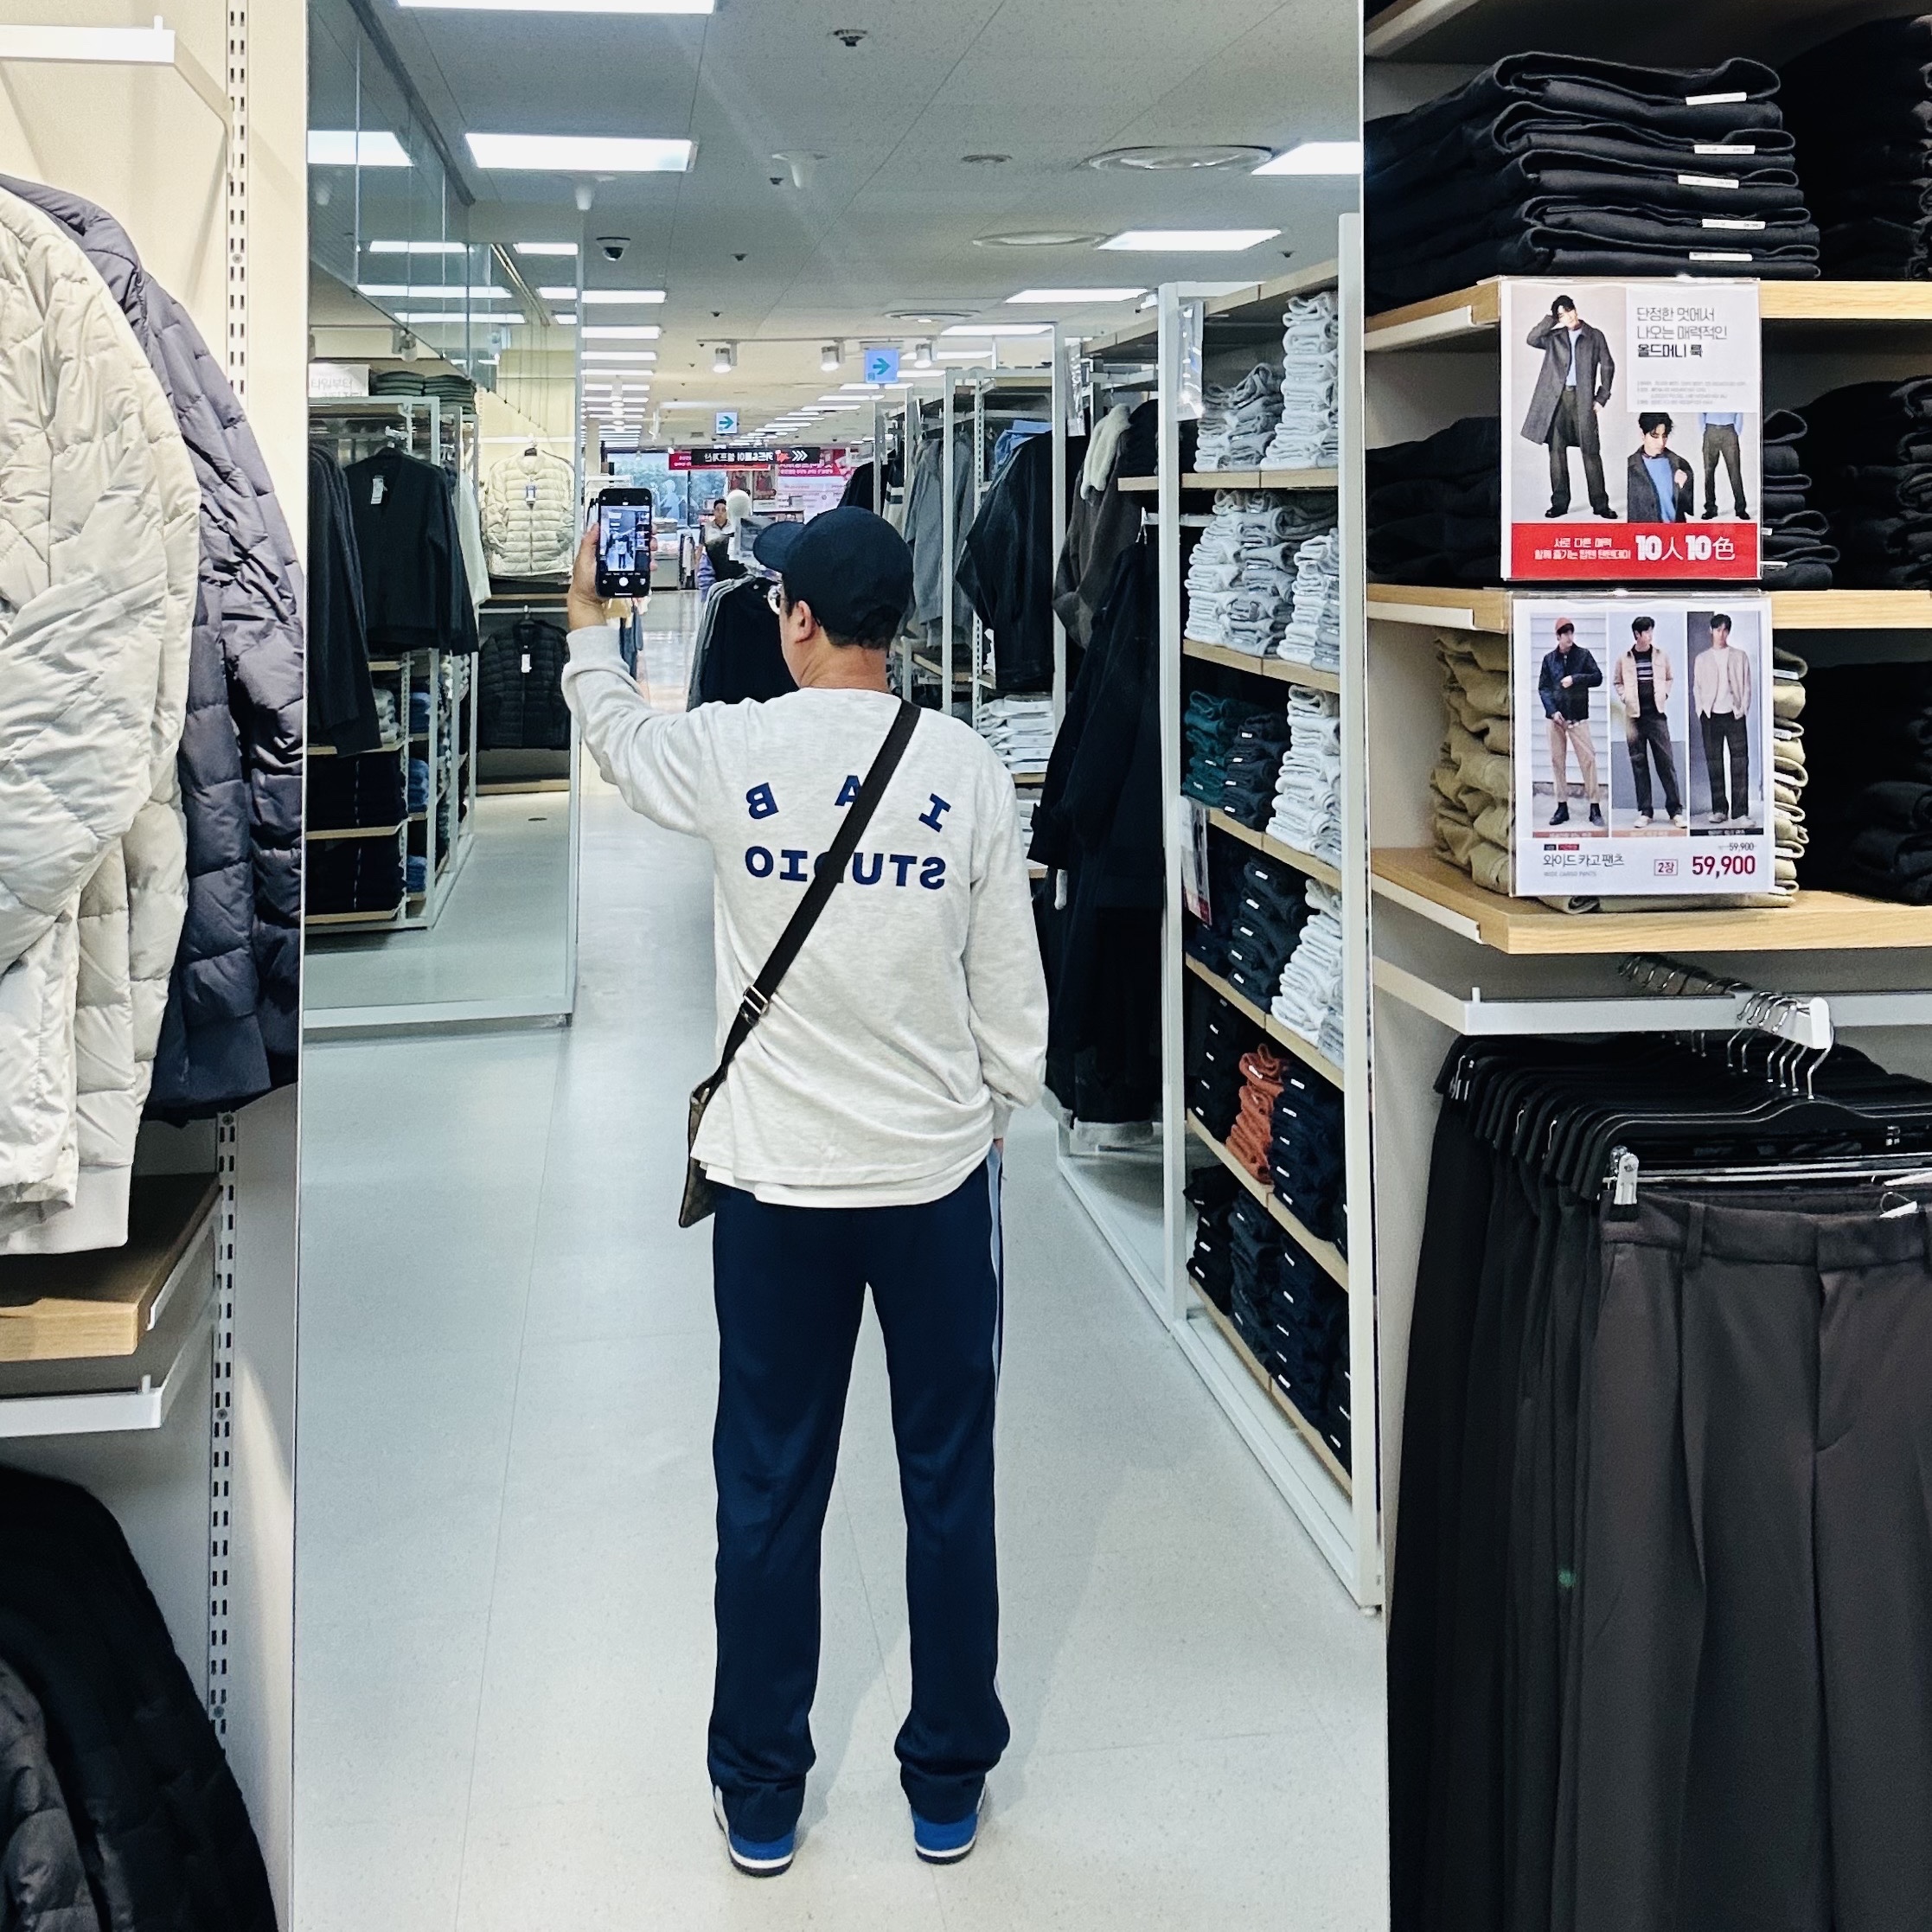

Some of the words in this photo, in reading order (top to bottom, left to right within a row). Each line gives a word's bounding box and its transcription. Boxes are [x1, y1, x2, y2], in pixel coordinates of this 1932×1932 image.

[1636, 307, 1674, 322] 단정한
[1677, 307, 1716, 322] 멋에서
[1636, 325, 1675, 340] 나오는
[1677, 325, 1728, 340] 매력적인
[1637, 343, 1687, 358] 올드머니
[1690, 343, 1704, 358] 룩
[1730, 842, 1755, 853] 59,900
[1543, 854, 1577, 867] 와이드
[1578, 854, 1602, 867] 카고
[1602, 853, 1625, 867] 팬츠
[1658, 861, 1675, 873] 2장
[1692, 855, 1756, 879] 59,900
